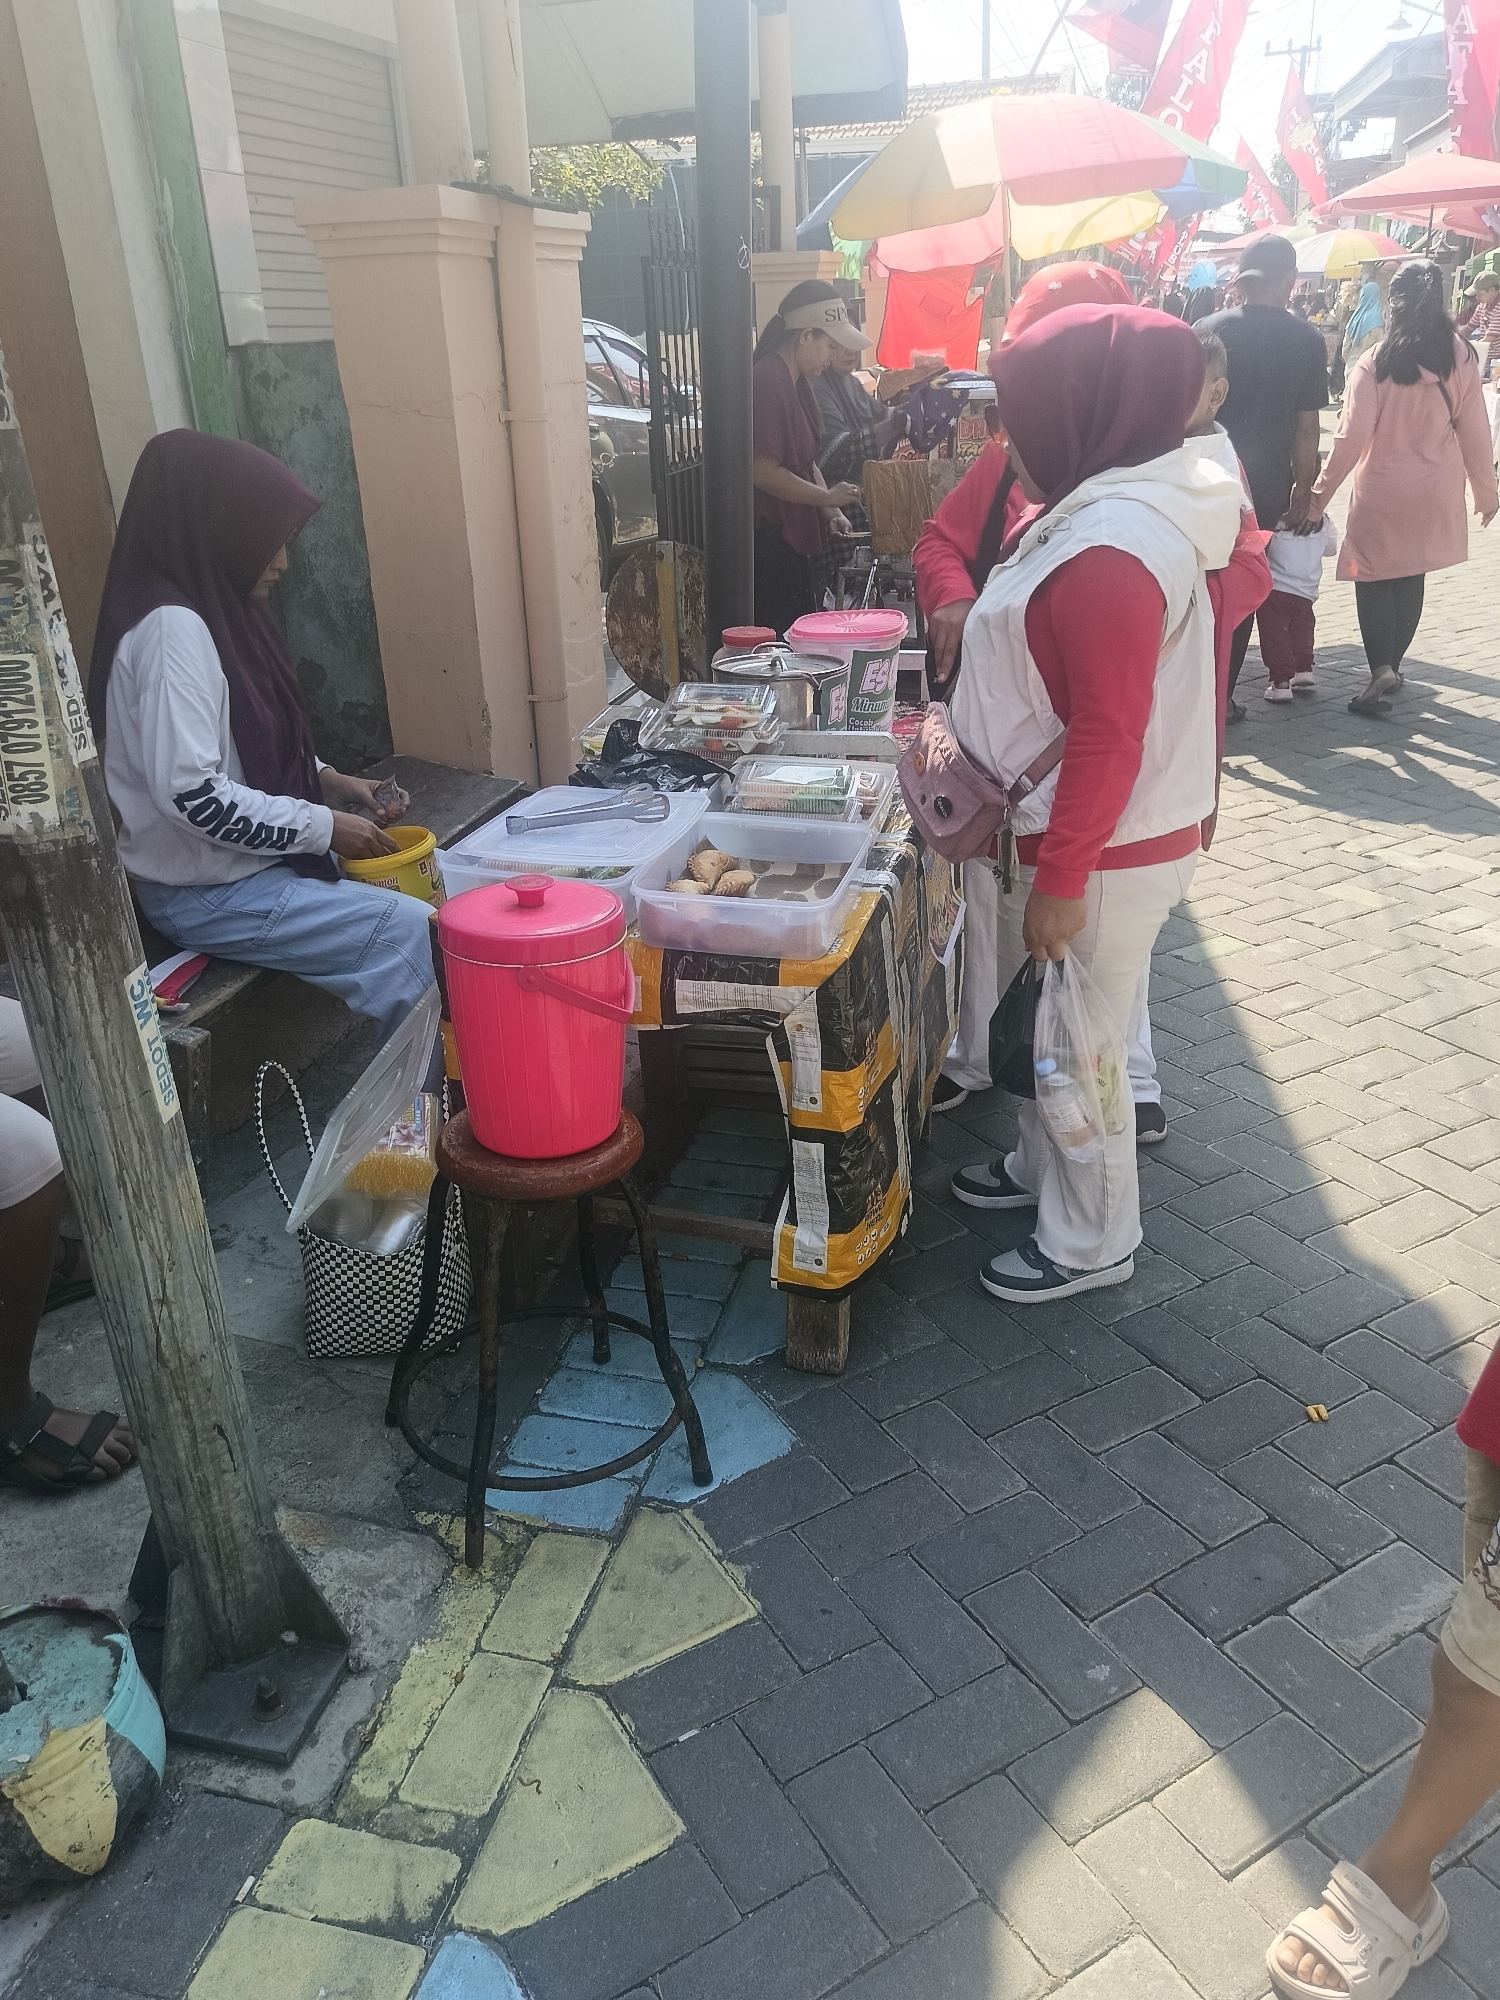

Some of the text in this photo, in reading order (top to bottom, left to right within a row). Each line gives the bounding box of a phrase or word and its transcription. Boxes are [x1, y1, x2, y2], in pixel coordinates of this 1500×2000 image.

[0, 659, 51, 806] 0857 07912000
[848, 717, 874, 728] Cocok
[129, 978, 153, 1032] WC
[147, 1037, 175, 1107] SEDOT
